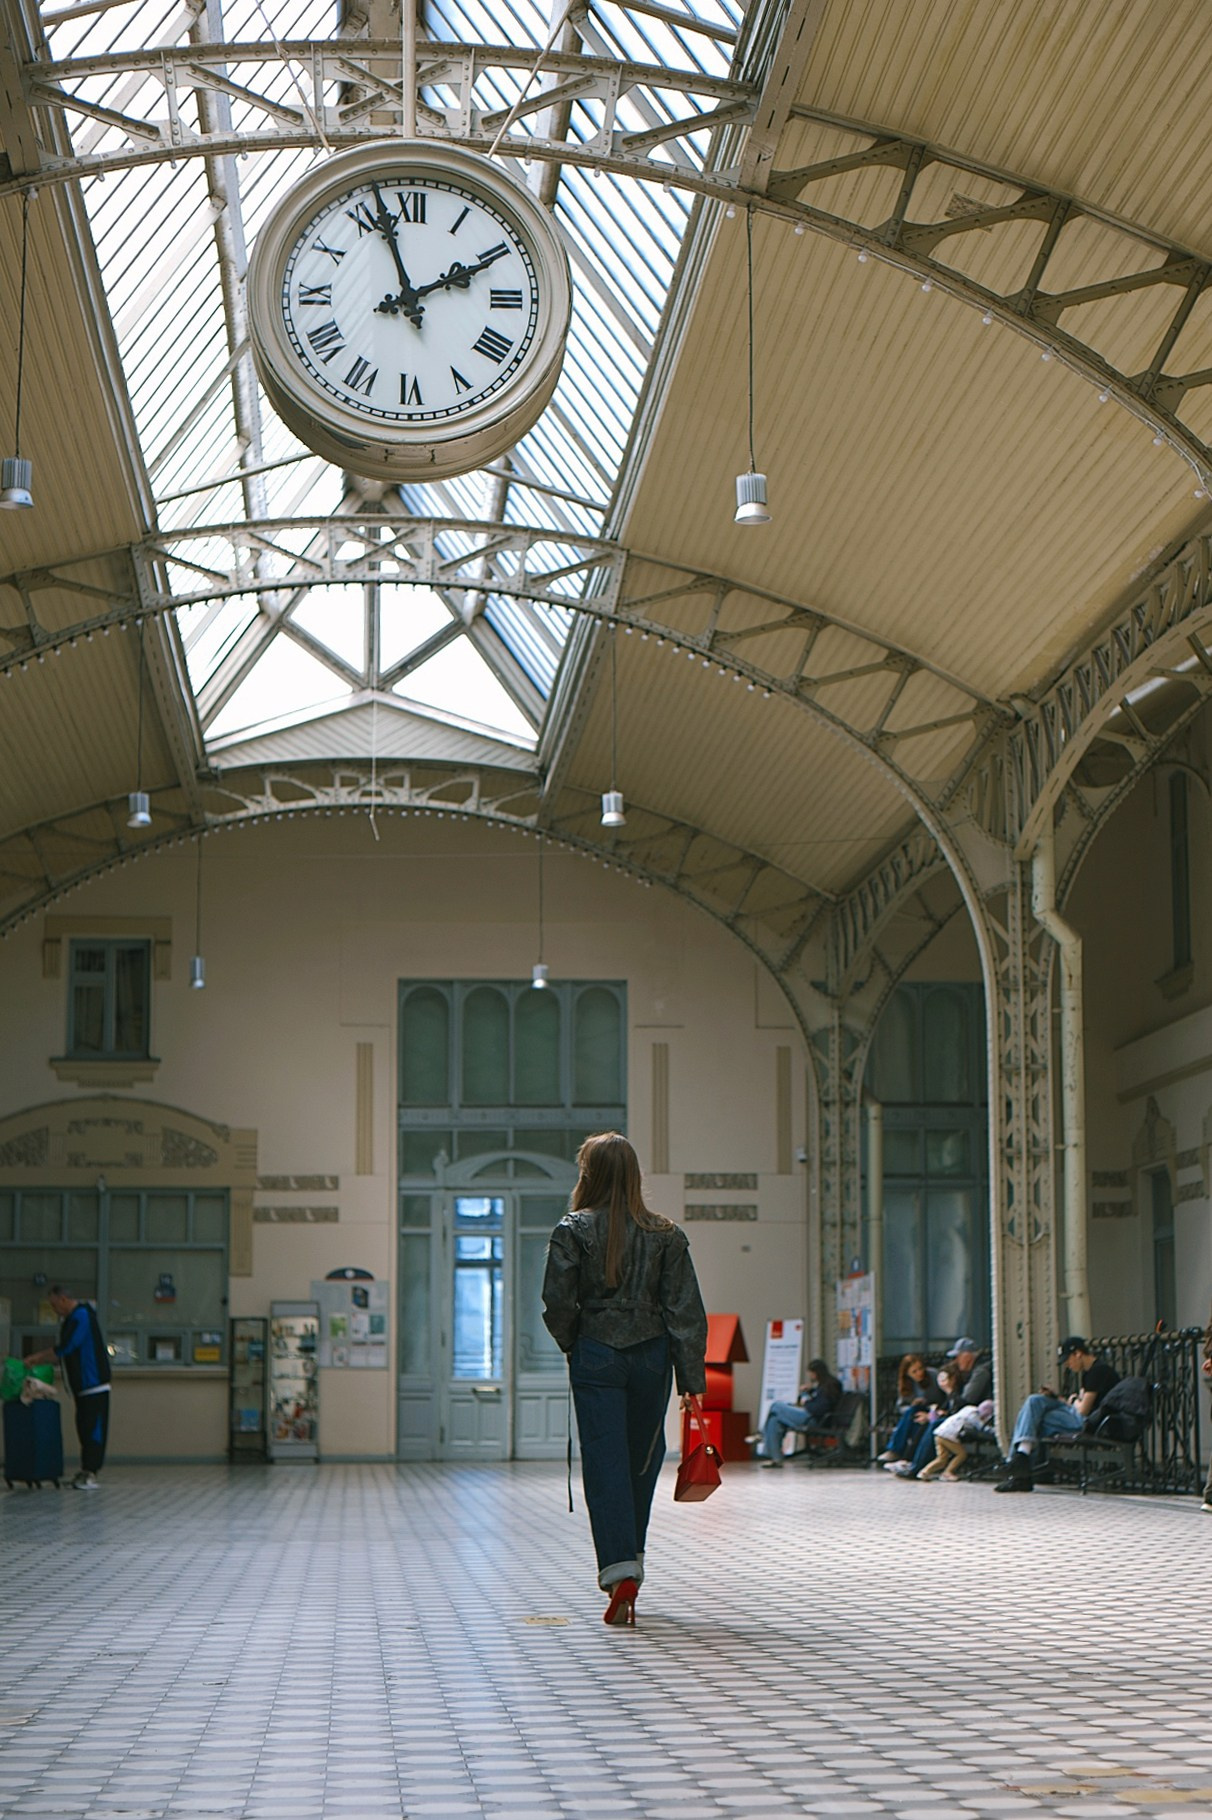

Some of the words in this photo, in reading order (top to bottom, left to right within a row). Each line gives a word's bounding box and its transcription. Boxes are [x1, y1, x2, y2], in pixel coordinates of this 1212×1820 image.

[344, 201, 379, 238] XI
[396, 191, 427, 224] XII
[447, 205, 472, 236] I
[312, 235, 346, 266] X
[475, 240, 512, 263] II
[298, 281, 332, 307] IX
[490, 288, 522, 310] III
[306, 319, 347, 365] VIII
[471, 325, 514, 365] IIII
[342, 355, 379, 397] VII
[399, 373, 425, 405] VI
[450, 365, 474, 395] V
